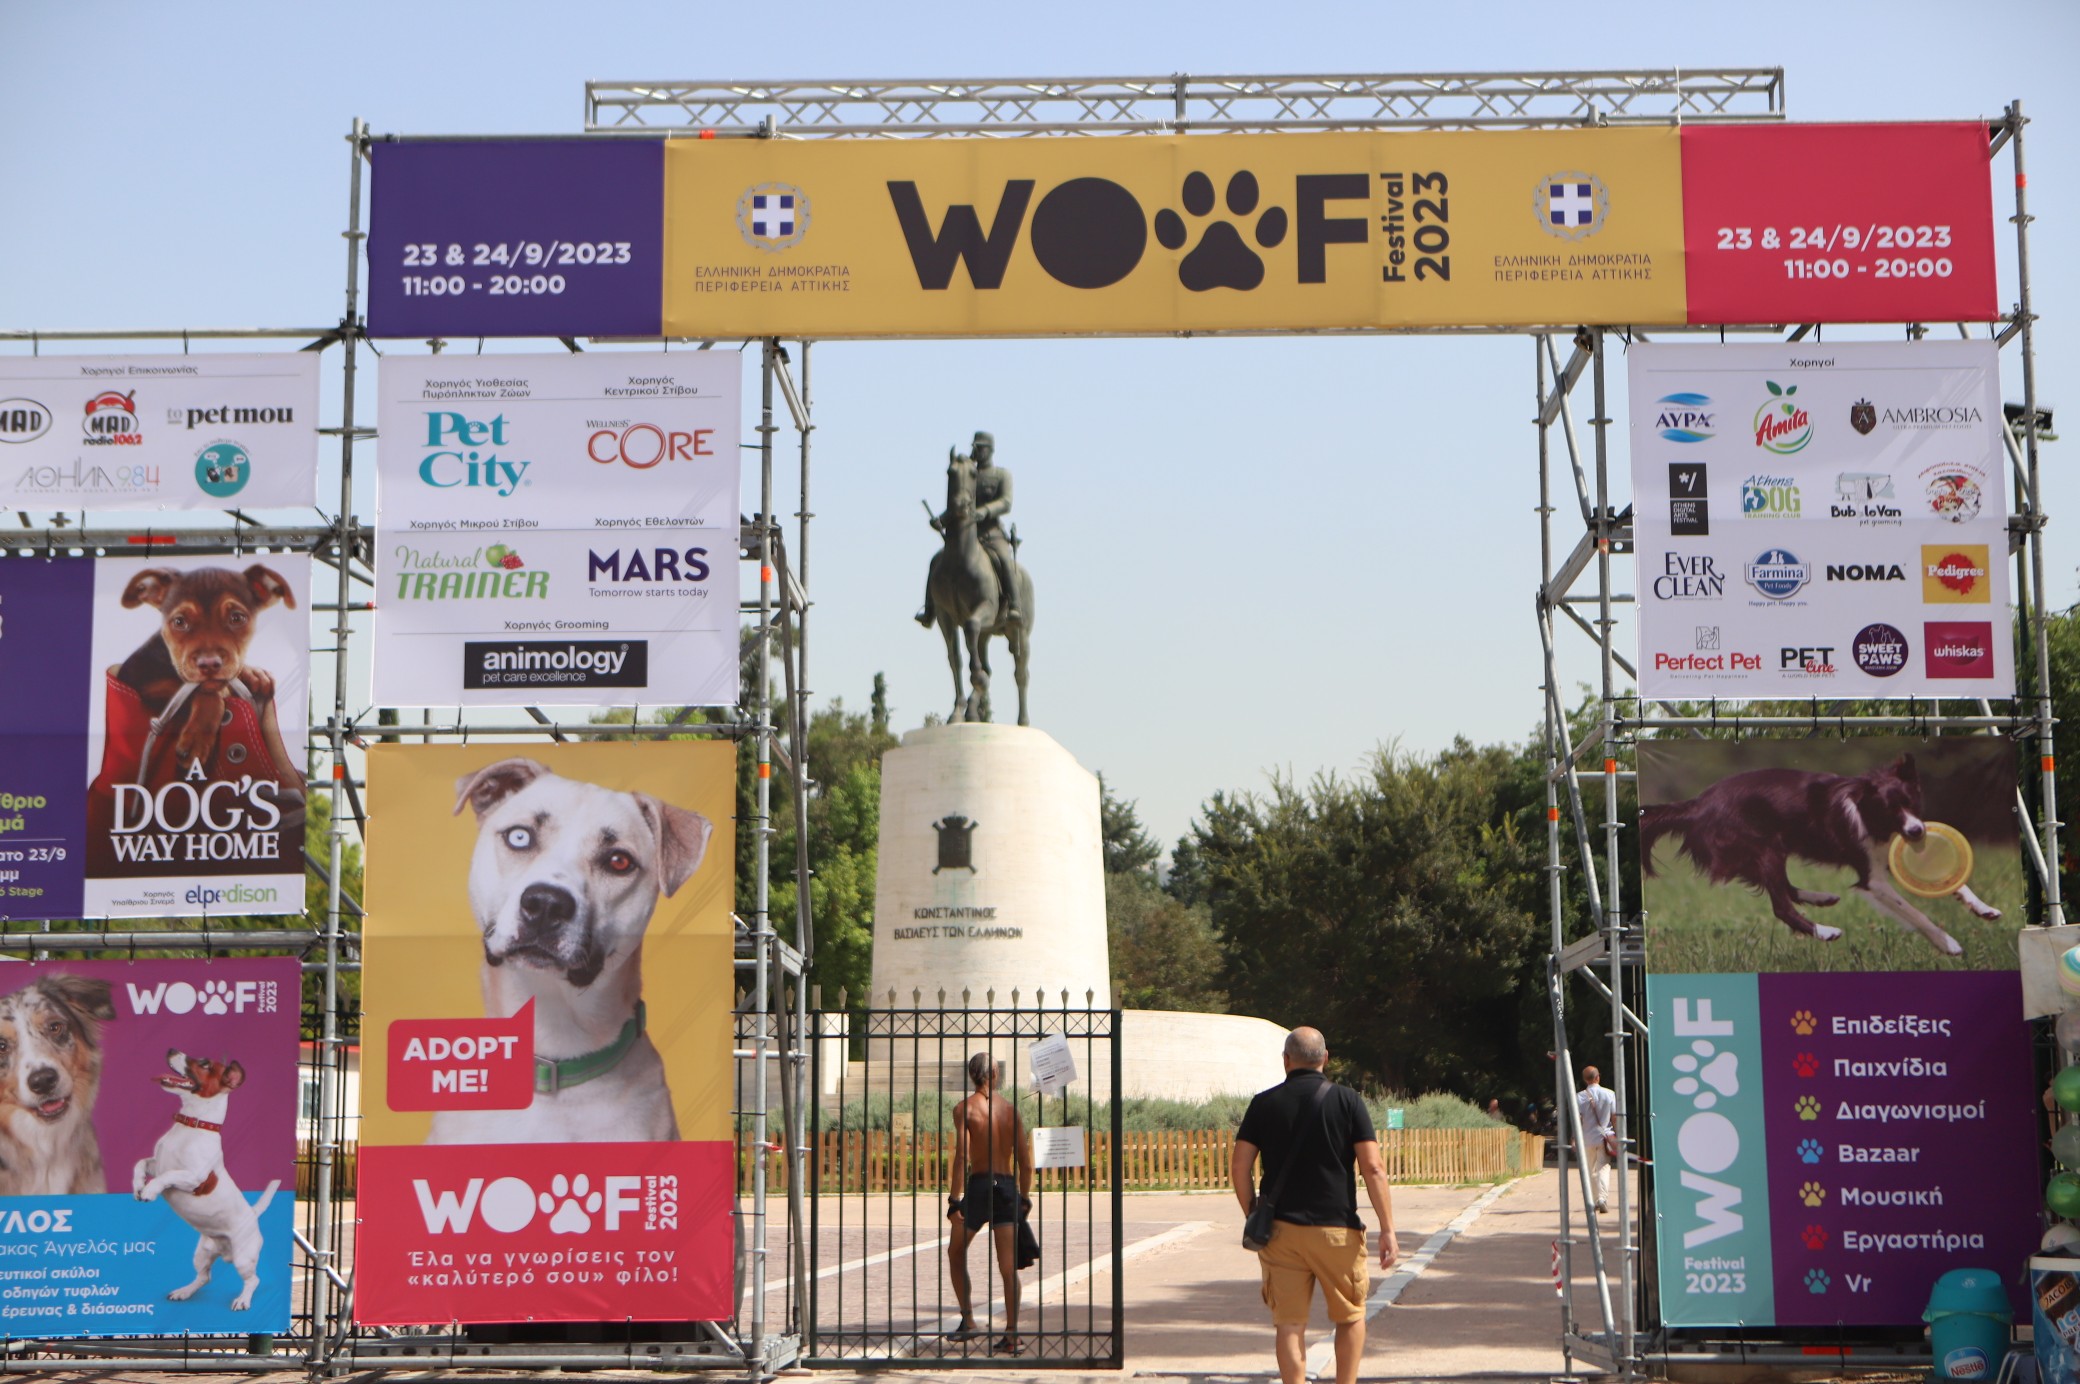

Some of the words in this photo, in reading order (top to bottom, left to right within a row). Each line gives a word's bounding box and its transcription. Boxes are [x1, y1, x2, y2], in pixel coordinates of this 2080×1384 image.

[1381, 172, 1406, 282] Festival
[1413, 170, 1450, 282] 2023
[1717, 228, 1753, 250] 23
[1761, 228, 1780, 250] &
[1789, 224, 1952, 252] 24/9/2023
[403, 243, 437, 266] 23
[445, 243, 465, 265] &
[474, 240, 631, 269] 24/9/2023
[1495, 255, 1561, 267] ΕΛΛΗΝΙΚΗ
[1568, 253, 1652, 266] ΔΗΜΟΚΡΑΤΙΑ
[696, 266, 761, 279] ΕΛΛΗΝΙΚΗ
[768, 264, 850, 277] ΔΗΜΟΚΡΑΤΙΑ
[1495, 269, 1583, 282] ΠΕΡΙΦΕΡΕΙΑ
[1592, 268, 1652, 281] ΑΤΤΙΚΗΣ
[1784, 259, 1849, 279] 11:00
[1875, 258, 1953, 278] 20:00
[402, 276, 465, 296] 11:00
[490, 275, 566, 295] 20:00
[696, 280, 782, 292] ΠΕΡΙΦΕΡΕΙΑ
[791, 279, 850, 292] ΑΤΤΙΚΗΣ
[1789, 357, 1835, 369] Χορηγοί
[425, 378, 473, 389] Χορηγός
[476, 377, 529, 388] Υιοθεσίας
[628, 376, 675, 387] Χορηγός
[422, 389, 496, 399] Πυρόπληκτων
[499, 388, 531, 398] Ζώων
[604, 386, 658, 397] Κεντρικού
[662, 385, 698, 395] Στίβου
[1882, 407, 1982, 423] AMBROSIA
[91, 416, 131, 434] MAD
[421, 411, 510, 447] Pet
[1755, 408, 1809, 447] Amita
[588, 422, 715, 470] CORE
[1744, 475, 1795, 487] Athens
[410, 520, 457, 530] Χορηγός
[460, 519, 500, 529] Μικρού
[503, 518, 539, 528] Στίβου
[595, 517, 642, 528] Χορηγός
[645, 516, 705, 526] Εθελοντών
[395, 545, 482, 568] Natural
[588, 547, 710, 582] MARS
[1665, 552, 1725, 580] EVER
[1752, 566, 1804, 579] Farmina
[1826, 564, 1906, 581] NOMA
[1927, 564, 1985, 579] Pedigree
[396, 571, 550, 600] TRAINER
[589, 588, 643, 598] Tomorrow
[646, 588, 675, 597] starts
[678, 587, 709, 599] today
[1653, 576, 1723, 600] CLEAN
[504, 621, 551, 632] Χορηγός
[555, 620, 610, 632] Grooming
[1859, 643, 1902, 654] SWEET
[1934, 646, 1984, 658] whiskas
[483, 645, 628, 675] animology
[1655, 652, 1724, 671] Perfect
[1731, 652, 1761, 670] Pet
[1780, 647, 1834, 669] PET
[1805, 659, 1838, 674] line
[1859, 654, 1903, 665] PAWS
[483, 673, 500, 684] pet
[503, 674, 527, 682] care
[529, 671, 586, 682] excellence
[185, 757, 207, 781] A
[109, 774, 281, 834] DOG'S
[28, 848, 67, 863] 23/9
[110, 834, 180, 862] WAY
[185, 832, 280, 861] HOME
[9, 887, 44, 898] Stage
[914, 907, 997, 920] ΚΩΝΣΤΑΝΤΙΝΟΣ
[894, 927, 939, 940] ΒΑΣΙΛΕΥΣ
[942, 926, 965, 938] ΤΩΝ
[968, 927, 1023, 939] ΕΛΛΗΝΩΝ
[266, 981, 278, 1013] 2023
[1832, 1016, 1951, 1037] Επιδείξεις
[402, 1036, 519, 1061] ADOPT
[1834, 1058, 1947, 1077] Παιχνίδια
[431, 1069, 489, 1093] ME!
[1836, 1100, 1985, 1123] Διαγωνισμοί
[1838, 1144, 1920, 1163] Bazaar
[645, 1175, 657, 1231] Festival
[659, 1174, 678, 1230] 2023
[1841, 1186, 1943, 1206] Μουσική
[44, 1238, 118, 1256] Άγγελός
[123, 1241, 156, 1255] μας
[1843, 1229, 1984, 1252] Εργαστήρια
[407, 1250, 454, 1267] Έλα
[466, 1253, 493, 1266] να
[504, 1248, 625, 1268] γνωρίσεις
[636, 1250, 675, 1263] τον
[1684, 1257, 1745, 1270] Festival
[51, 1266, 100, 1279] σκύλοι
[408, 1268, 535, 1288] «καλύτερό
[547, 1270, 604, 1284] σου»
[616, 1266, 679, 1285] φίλο!
[2, 1285, 60, 1300] οδηγών
[63, 1284, 120, 1299] τυφλών
[1685, 1273, 1746, 1293] 2023
[1845, 1274, 1872, 1292] Vr
[2, 1305, 63, 1319] έρευνας
[66, 1304, 77, 1315] &
[81, 1302, 155, 1315] διάσωσης
